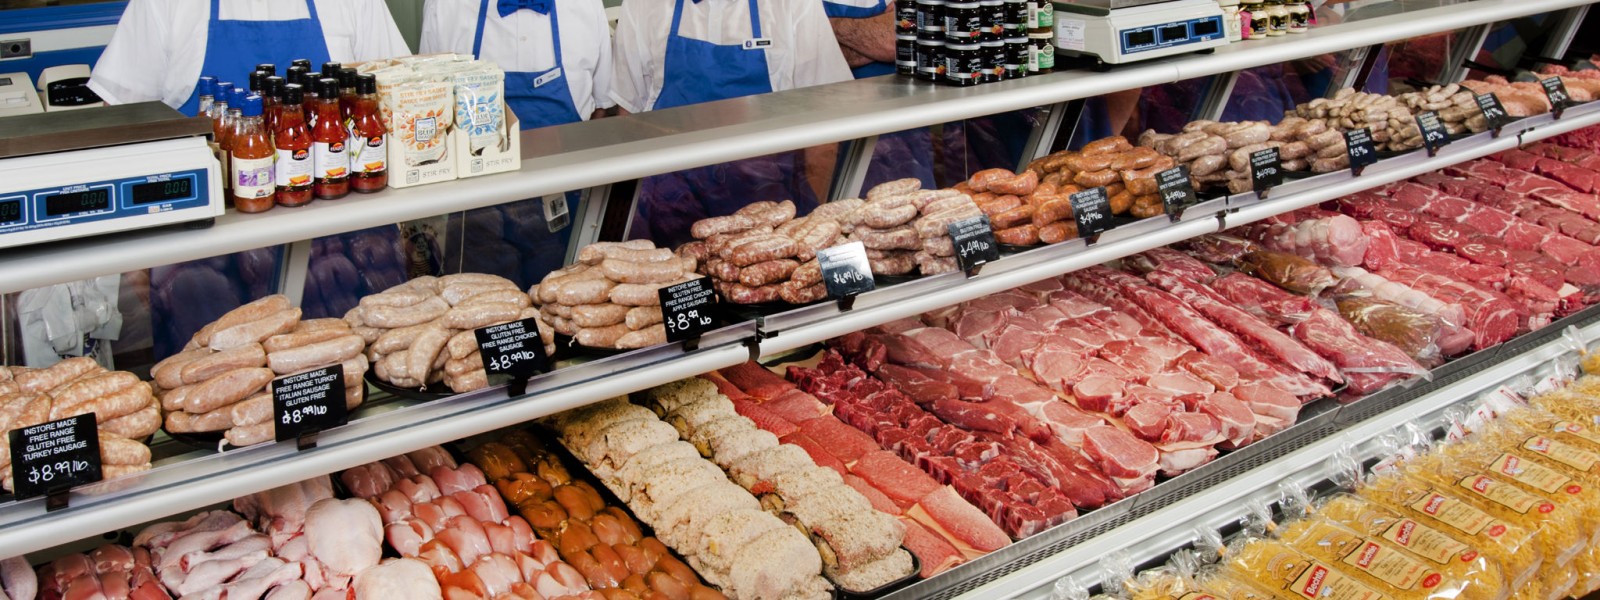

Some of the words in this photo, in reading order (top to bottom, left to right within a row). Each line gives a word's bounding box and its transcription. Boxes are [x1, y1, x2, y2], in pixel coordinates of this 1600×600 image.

[438, 168, 451, 176] FRY
[673, 291, 690, 299] GLUTEN
[690, 286, 702, 294] FREE
[678, 295, 693, 303] RANGE
[693, 289, 713, 299] CHICKEN
[687, 297, 707, 308] SAUSAGE
[491, 331, 512, 340] GLUTEN
[496, 337, 514, 346] RANGE
[515, 331, 537, 341] CHICKEN
[499, 342, 523, 352] SAUSAGE
[276, 386, 292, 394] FREE
[293, 380, 314, 390] RANGE
[314, 374, 338, 384] TURKEY
[283, 373, 309, 385] INSTORE
[310, 369, 327, 379] MADE
[279, 390, 302, 401] ITALIAN
[302, 383, 330, 396] SAUSAGE
[286, 396, 310, 407] GLUTEN
[310, 391, 326, 400] FREE
[24, 423, 55, 436] INSTORE
[57, 418, 77, 428] MADE
[30, 433, 49, 443] FREE
[50, 427, 75, 438] RANGE
[23, 449, 52, 461] TURKEY
[53, 440, 87, 454] SAUSAGE
[26, 440, 55, 452] GLUTEN
[57, 435, 75, 445] FREE
[1398, 522, 1414, 544] Bechtle
[1359, 545, 1377, 565] Bechtle
[1306, 569, 1326, 594] Bechtle
